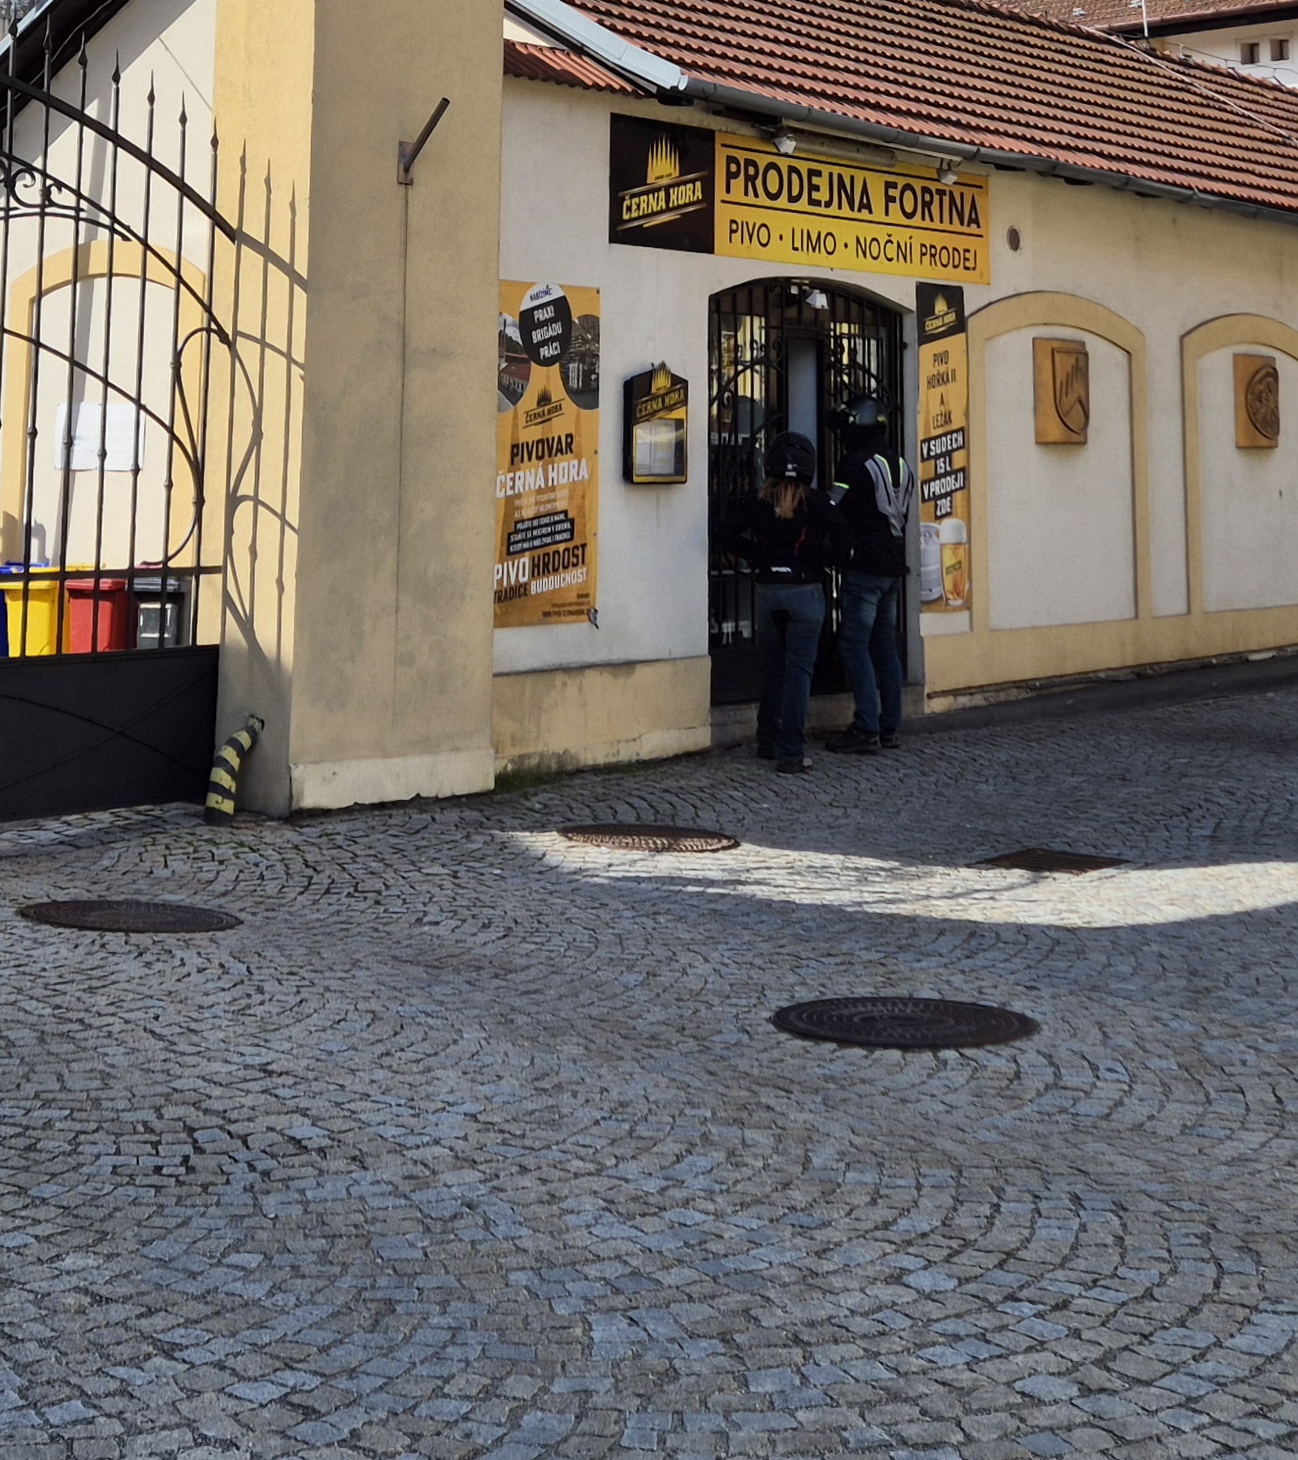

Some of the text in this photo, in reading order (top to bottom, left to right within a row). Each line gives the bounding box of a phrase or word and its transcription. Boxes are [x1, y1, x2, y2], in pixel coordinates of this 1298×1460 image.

[622, 181, 702, 220] ČERNÁ HORA
[724, 154, 982, 229] PRODEJNA FORTNA
[729, 219, 977, 271] PIVO LIMO NOČNÍ PRODEJ
[533, 305, 555, 323] PRAXI
[531, 321, 562, 344] BRIGÁDU
[539, 341, 561, 360] PRÁCI
[933, 349, 950, 368] PIVO
[926, 367, 950, 390] HOŘKÁ
[939, 392, 945, 407] A
[932, 407, 953, 430] LEŽÁK
[510, 432, 574, 466] PIVOVAR
[921, 431, 964, 459] V SUDECH
[936, 457, 945, 474] 15
[496, 461, 545, 498] ČERNÁ
[548, 458, 589, 487] HORA
[923, 476, 964, 500] V PRODEJI
[936, 496, 952, 516] ZDE
[494, 543, 587, 589] PIVO HRDOST
[494, 567, 587, 605] TRADICE BUDOUCNOST
